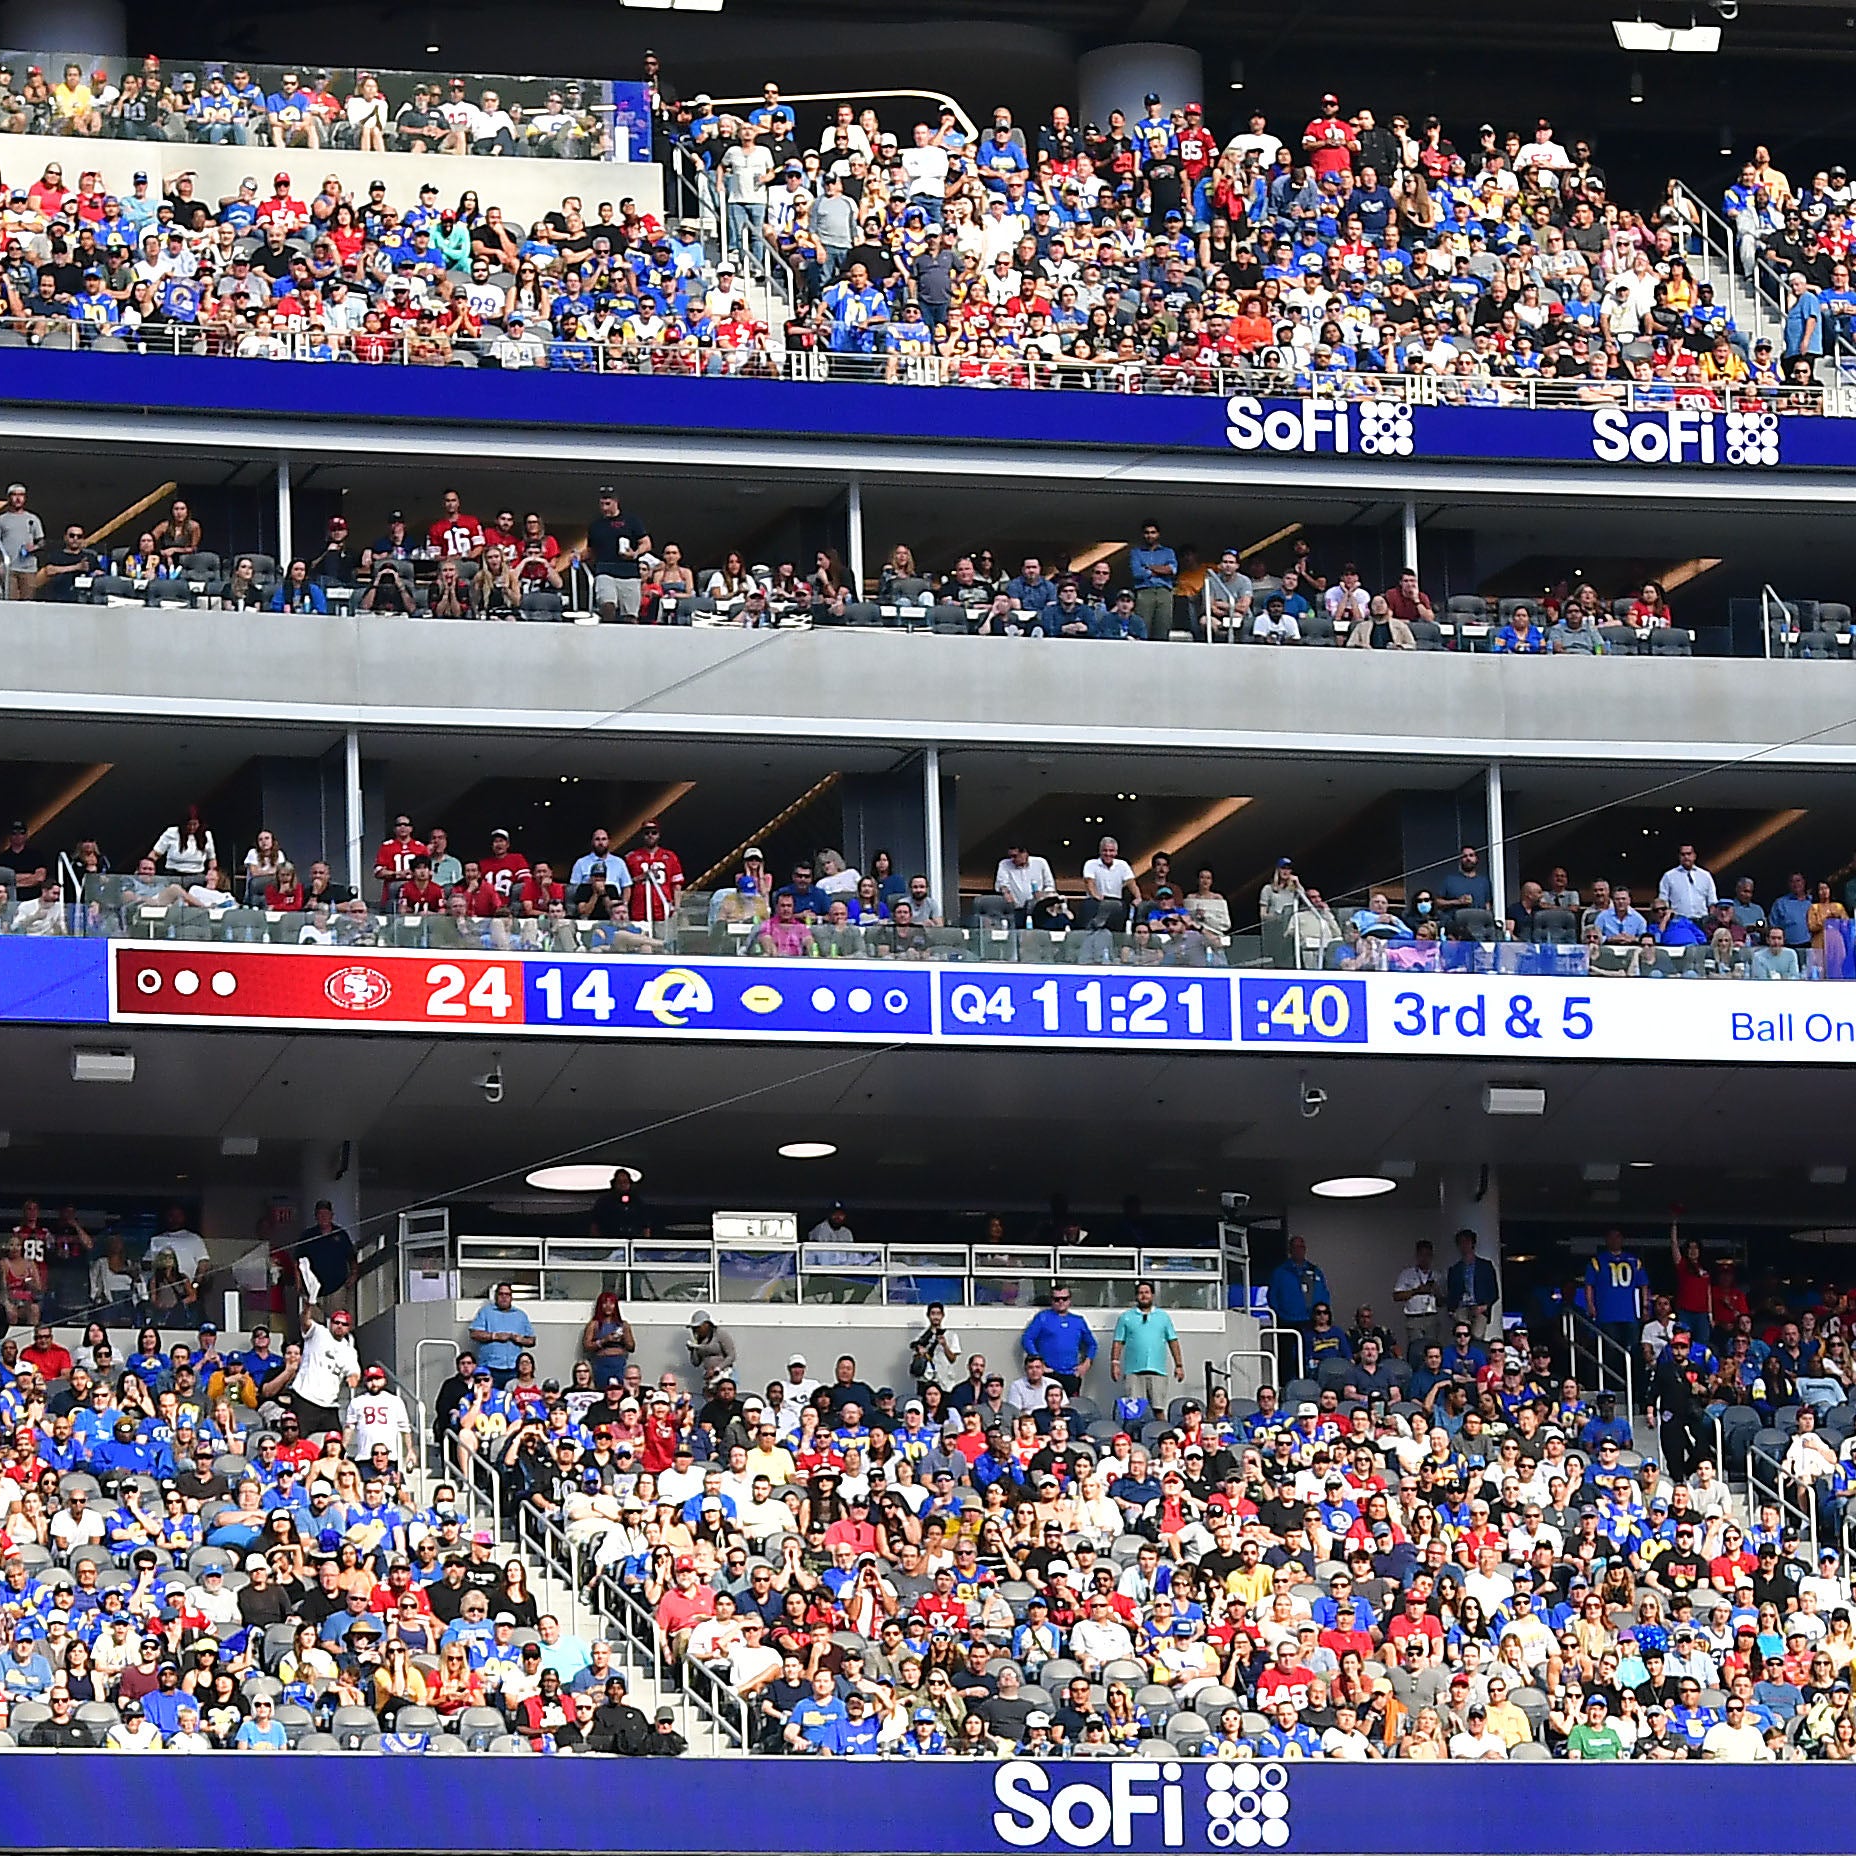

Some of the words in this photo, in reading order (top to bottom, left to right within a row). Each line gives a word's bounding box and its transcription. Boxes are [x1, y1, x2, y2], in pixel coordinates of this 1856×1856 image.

[1226, 397, 1349, 454] SoFi
[1594, 408, 1716, 465] SoFi
[427, 965, 512, 1017] 24
[536, 969, 615, 1019] 14
[952, 985, 1015, 1024] Q4
[1033, 980, 1203, 1033] 11:21
[1257, 985, 1349, 1036] :40
[1394, 992, 1485, 1037] 3rd
[1505, 995, 1542, 1038] &
[1563, 997, 1592, 1039] 5
[1732, 1013, 1792, 1041] Ball
[1806, 1014, 1854, 1042] On
[1610, 1262, 1631, 1286] 10
[994, 1761, 1182, 1846] SoFi
